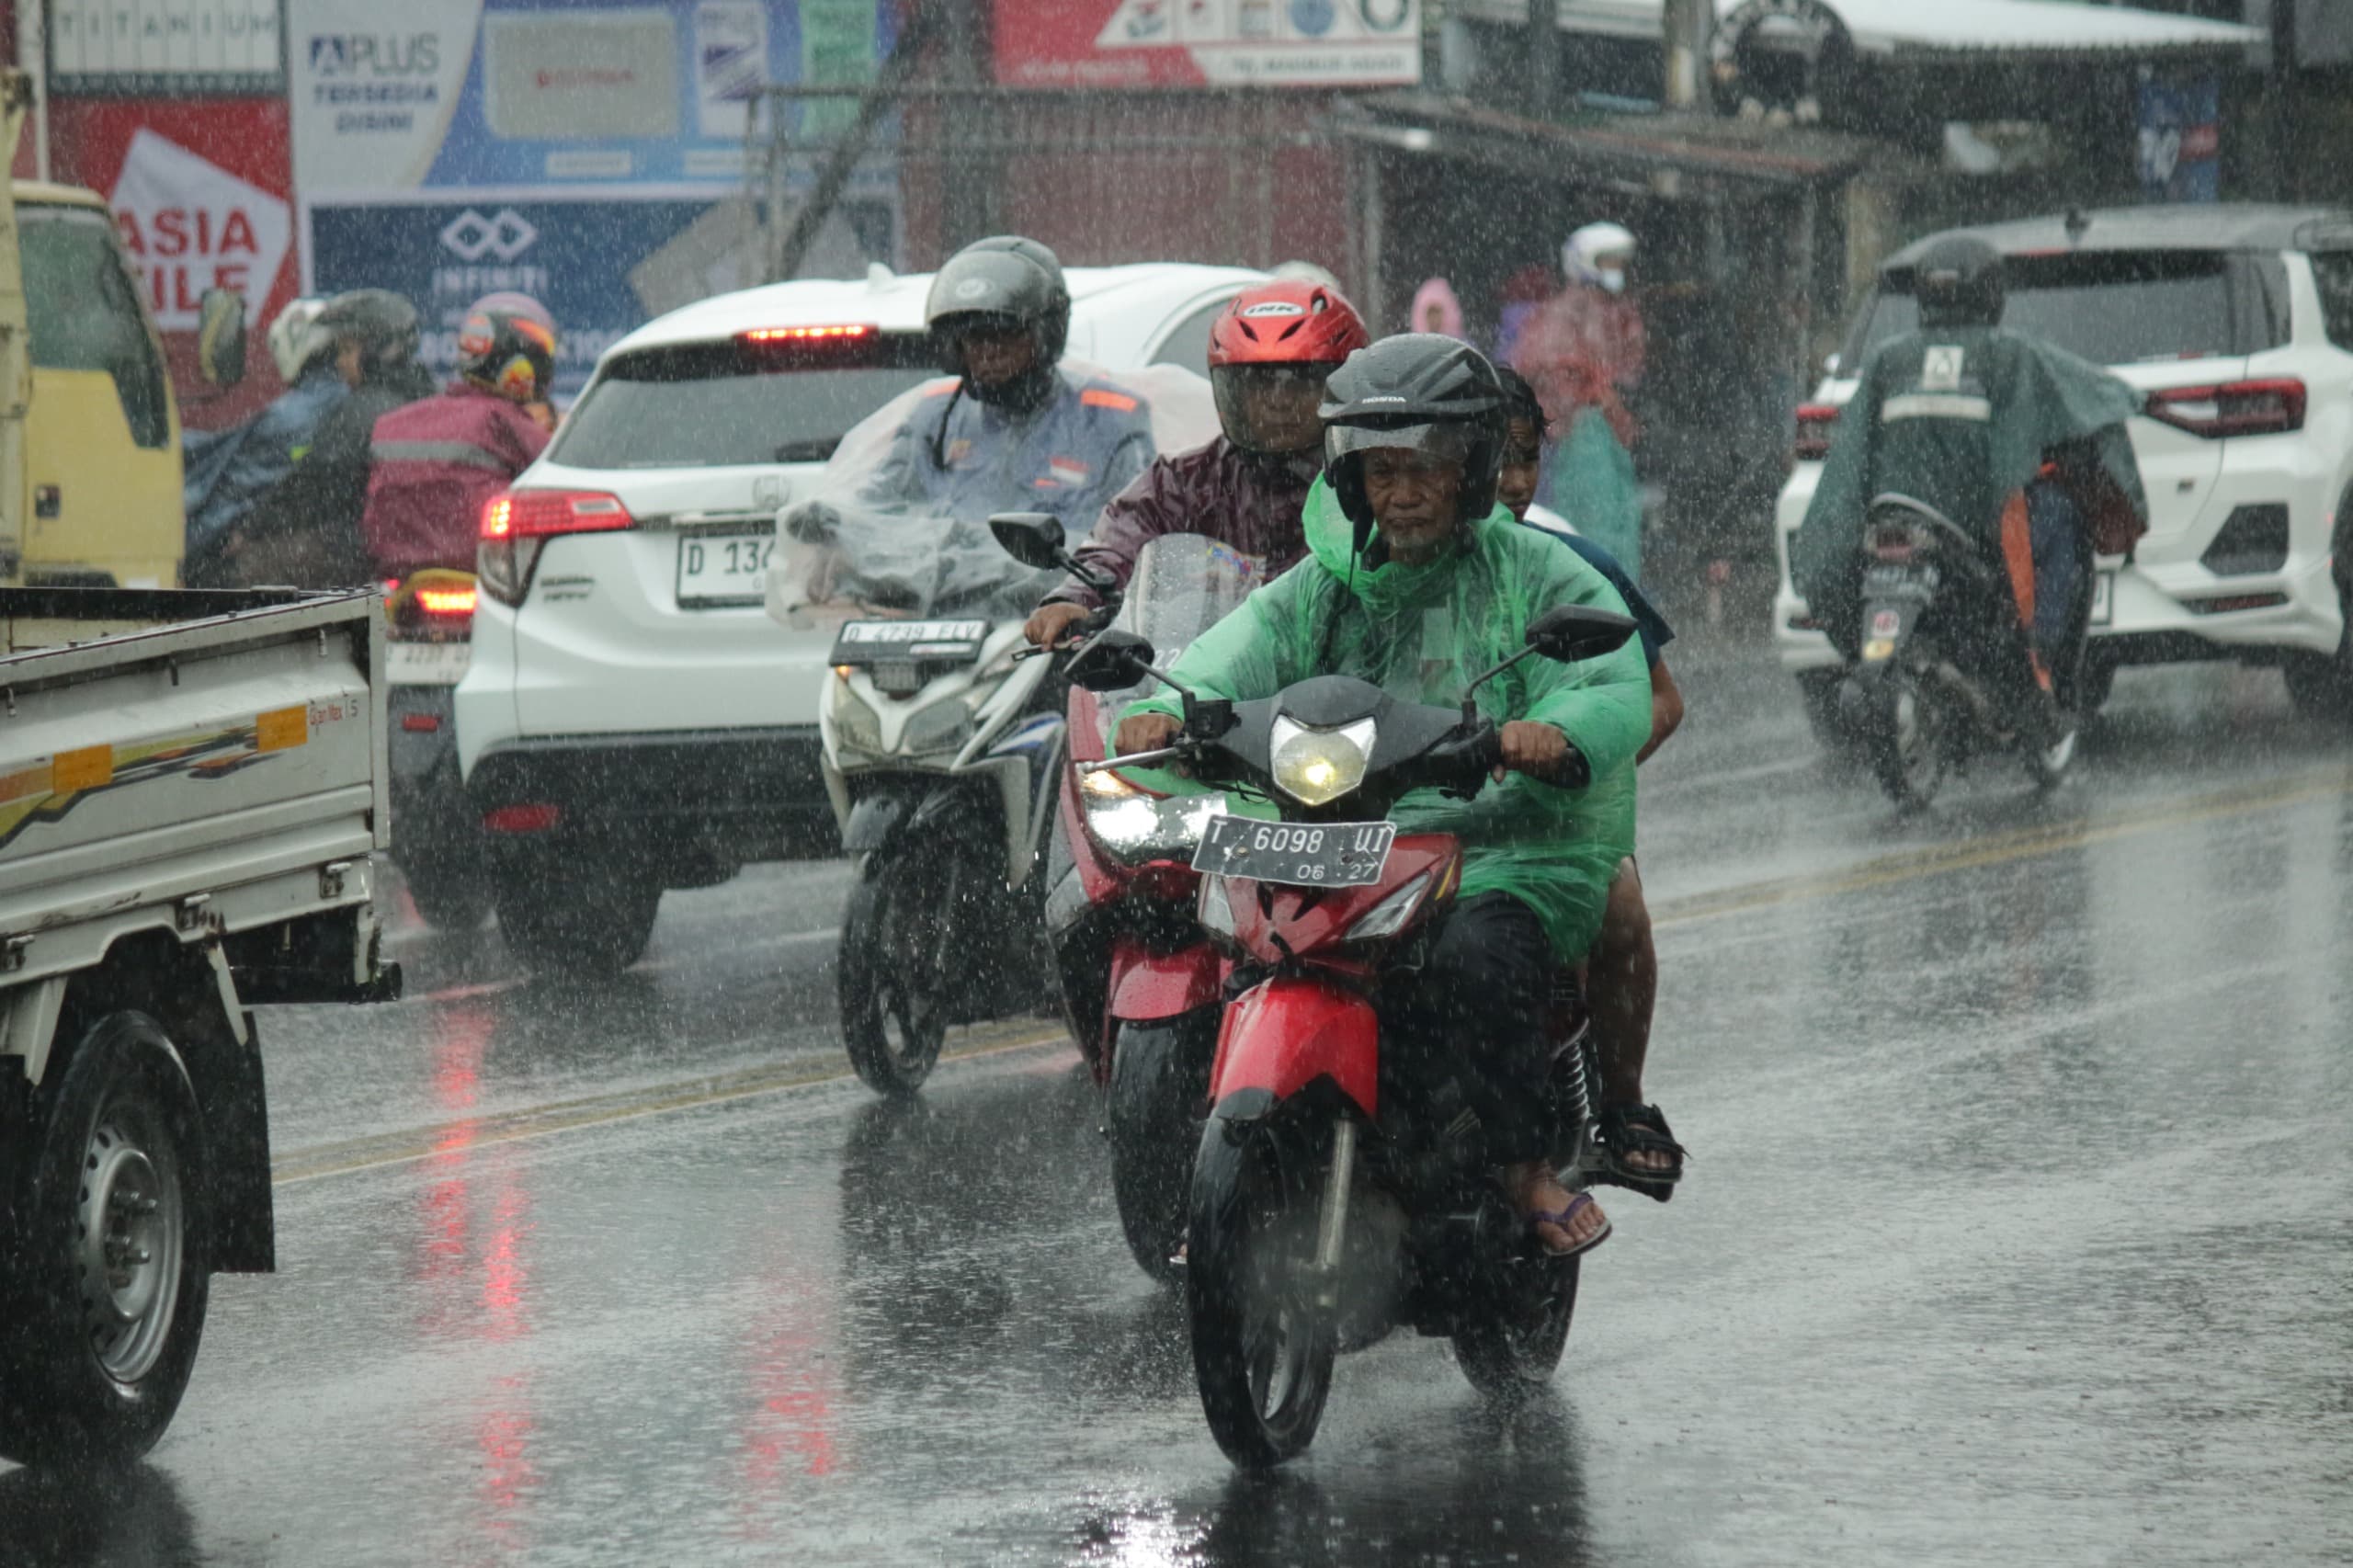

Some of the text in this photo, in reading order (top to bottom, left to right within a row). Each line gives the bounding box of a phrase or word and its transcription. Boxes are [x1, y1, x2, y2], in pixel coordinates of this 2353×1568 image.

[60, 11, 275, 37] TITANIUM
[118, 209, 258, 256] ASIA
[153, 264, 249, 312] ILE
[1361, 395, 1407, 404] HONDA
[688, 543, 704, 574] D
[1211, 819, 1228, 845] T
[1253, 826, 1324, 854] 6098
[1297, 863, 1376, 881] 06 27
